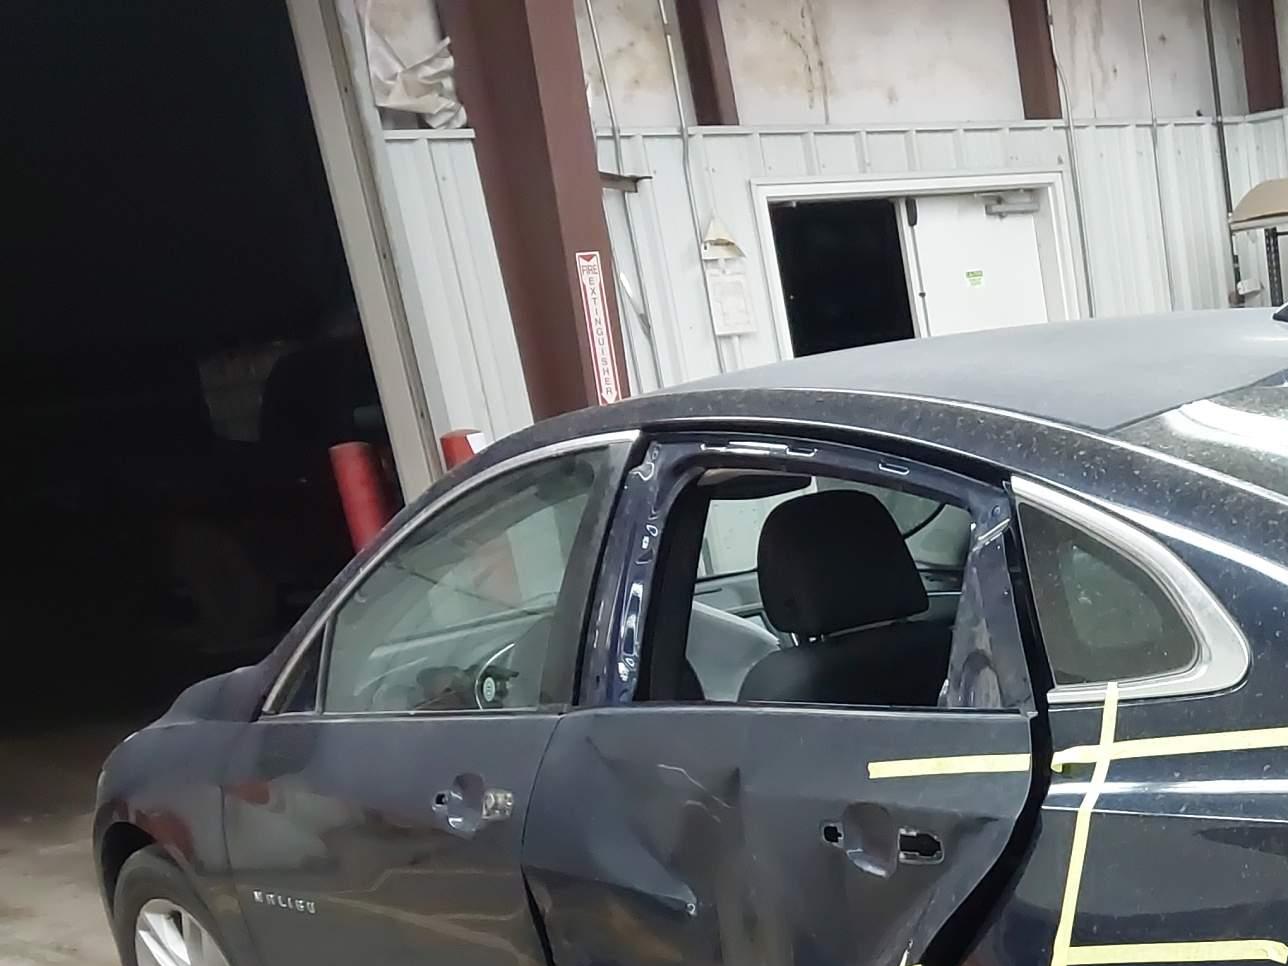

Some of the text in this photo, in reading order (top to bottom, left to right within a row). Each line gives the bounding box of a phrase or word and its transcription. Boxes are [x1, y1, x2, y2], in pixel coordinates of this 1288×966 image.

[582, 265, 599, 275] FIRE
[588, 277, 613, 395] EXTINGUISHER
[252, 890, 316, 914] MALIBU
